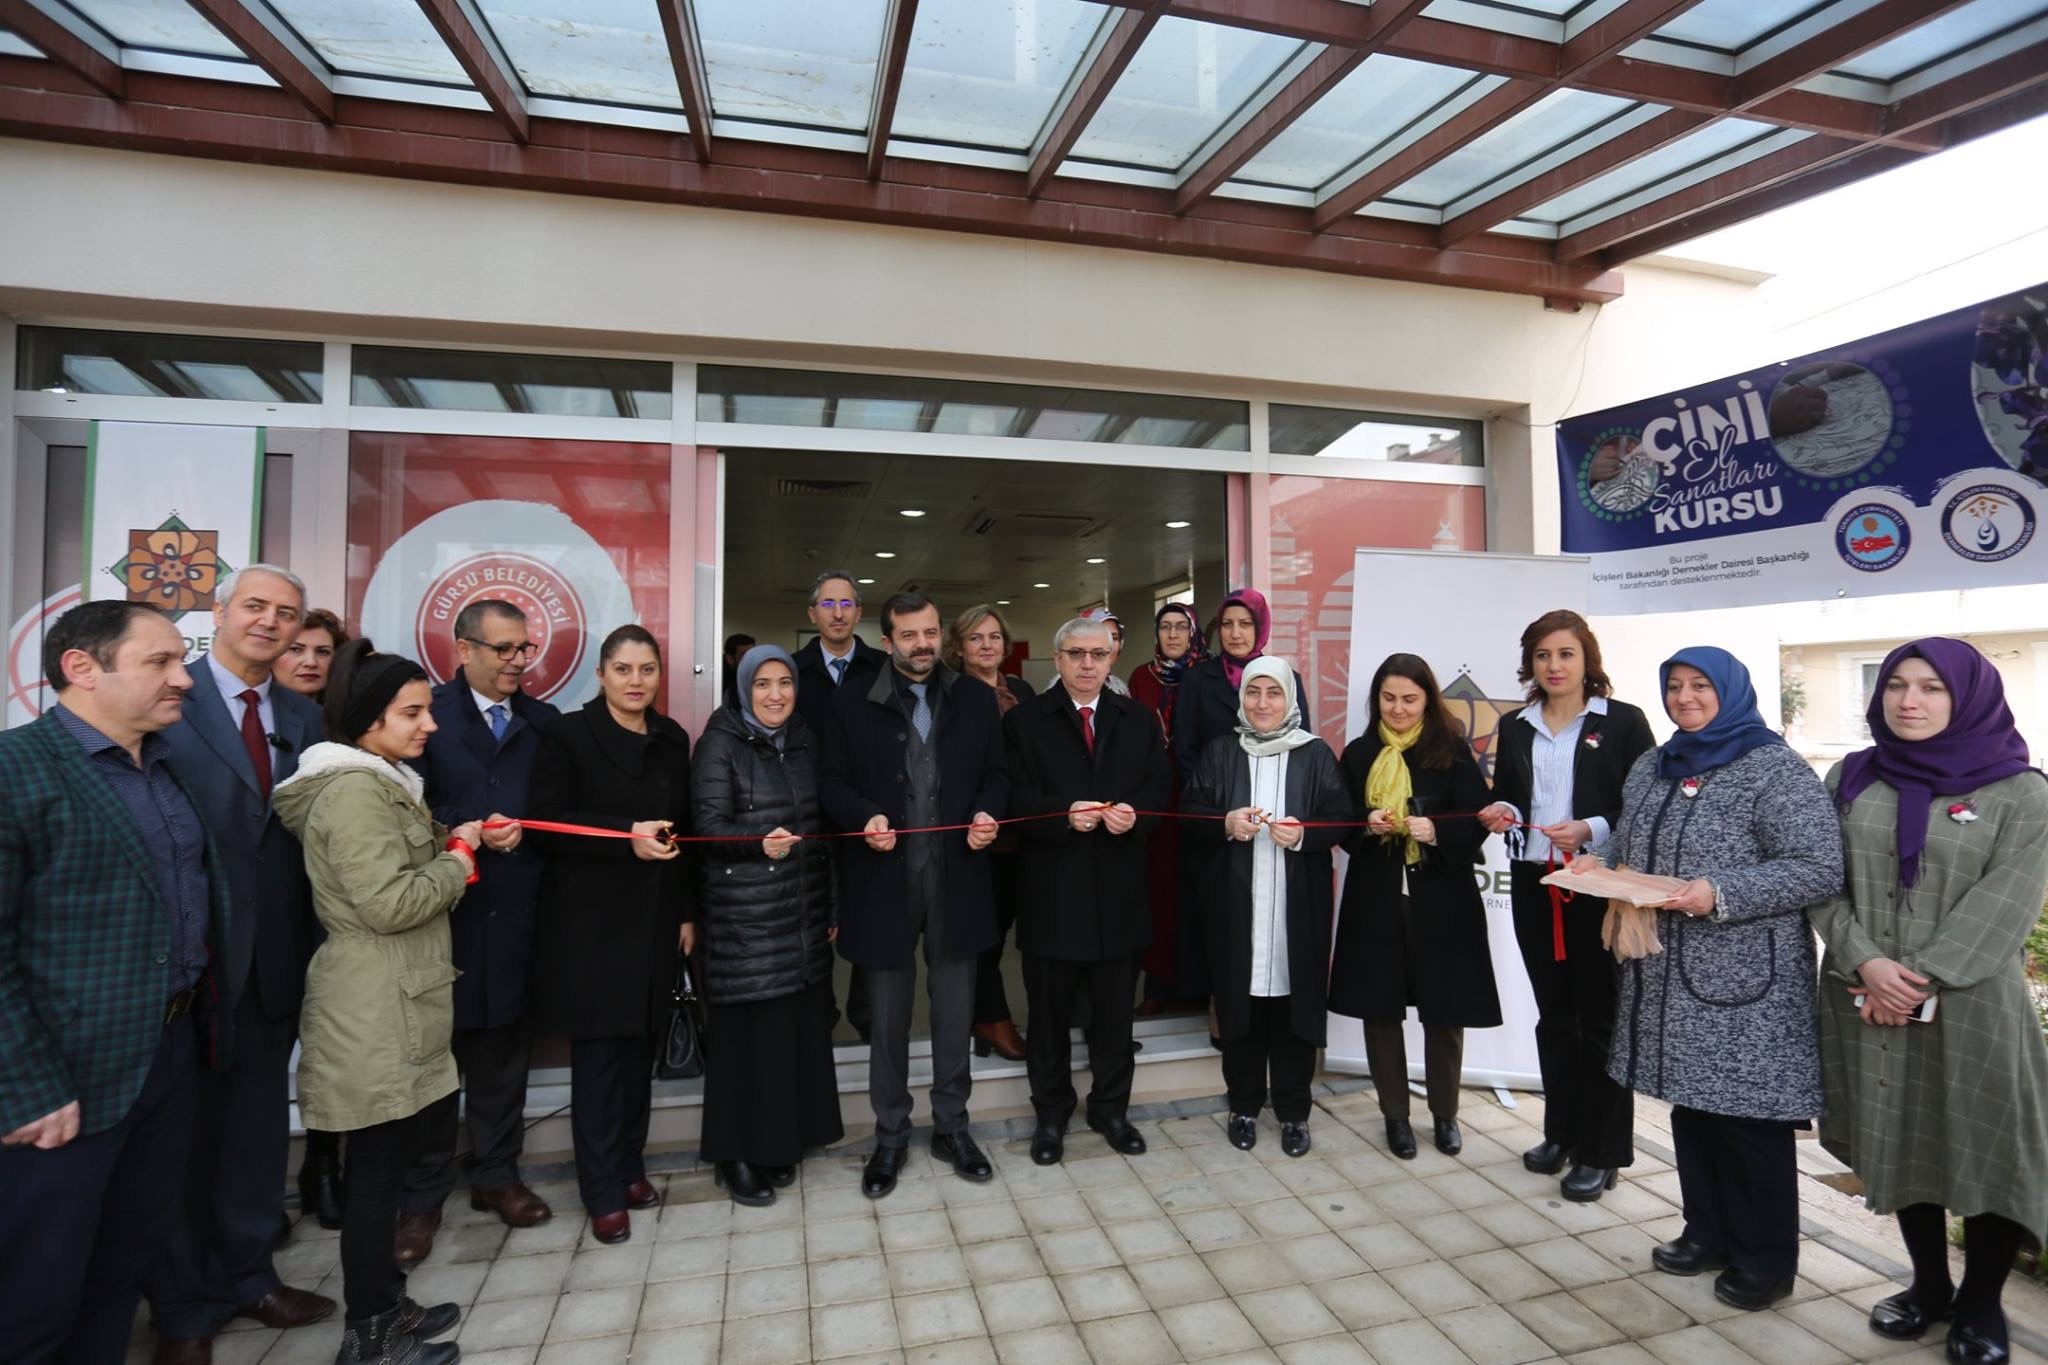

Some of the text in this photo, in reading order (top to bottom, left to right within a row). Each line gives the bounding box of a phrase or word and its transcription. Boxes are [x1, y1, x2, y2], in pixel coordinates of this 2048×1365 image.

[1642, 380, 1770, 476] ÇİNİ
[1683, 427, 1736, 482] El
[1649, 460, 1778, 512] Sanatları
[1655, 486, 1783, 534] KURSU
[1592, 551, 1810, 582] İçişleri Bakanlığı Dernekler Dairesi Başkanlığı
[1620, 569, 1763, 590] tarafından desteklenmektedir.
[1669, 553, 1708, 565] Bu proje
[483, 567, 571, 623] BELEDİYESİ
